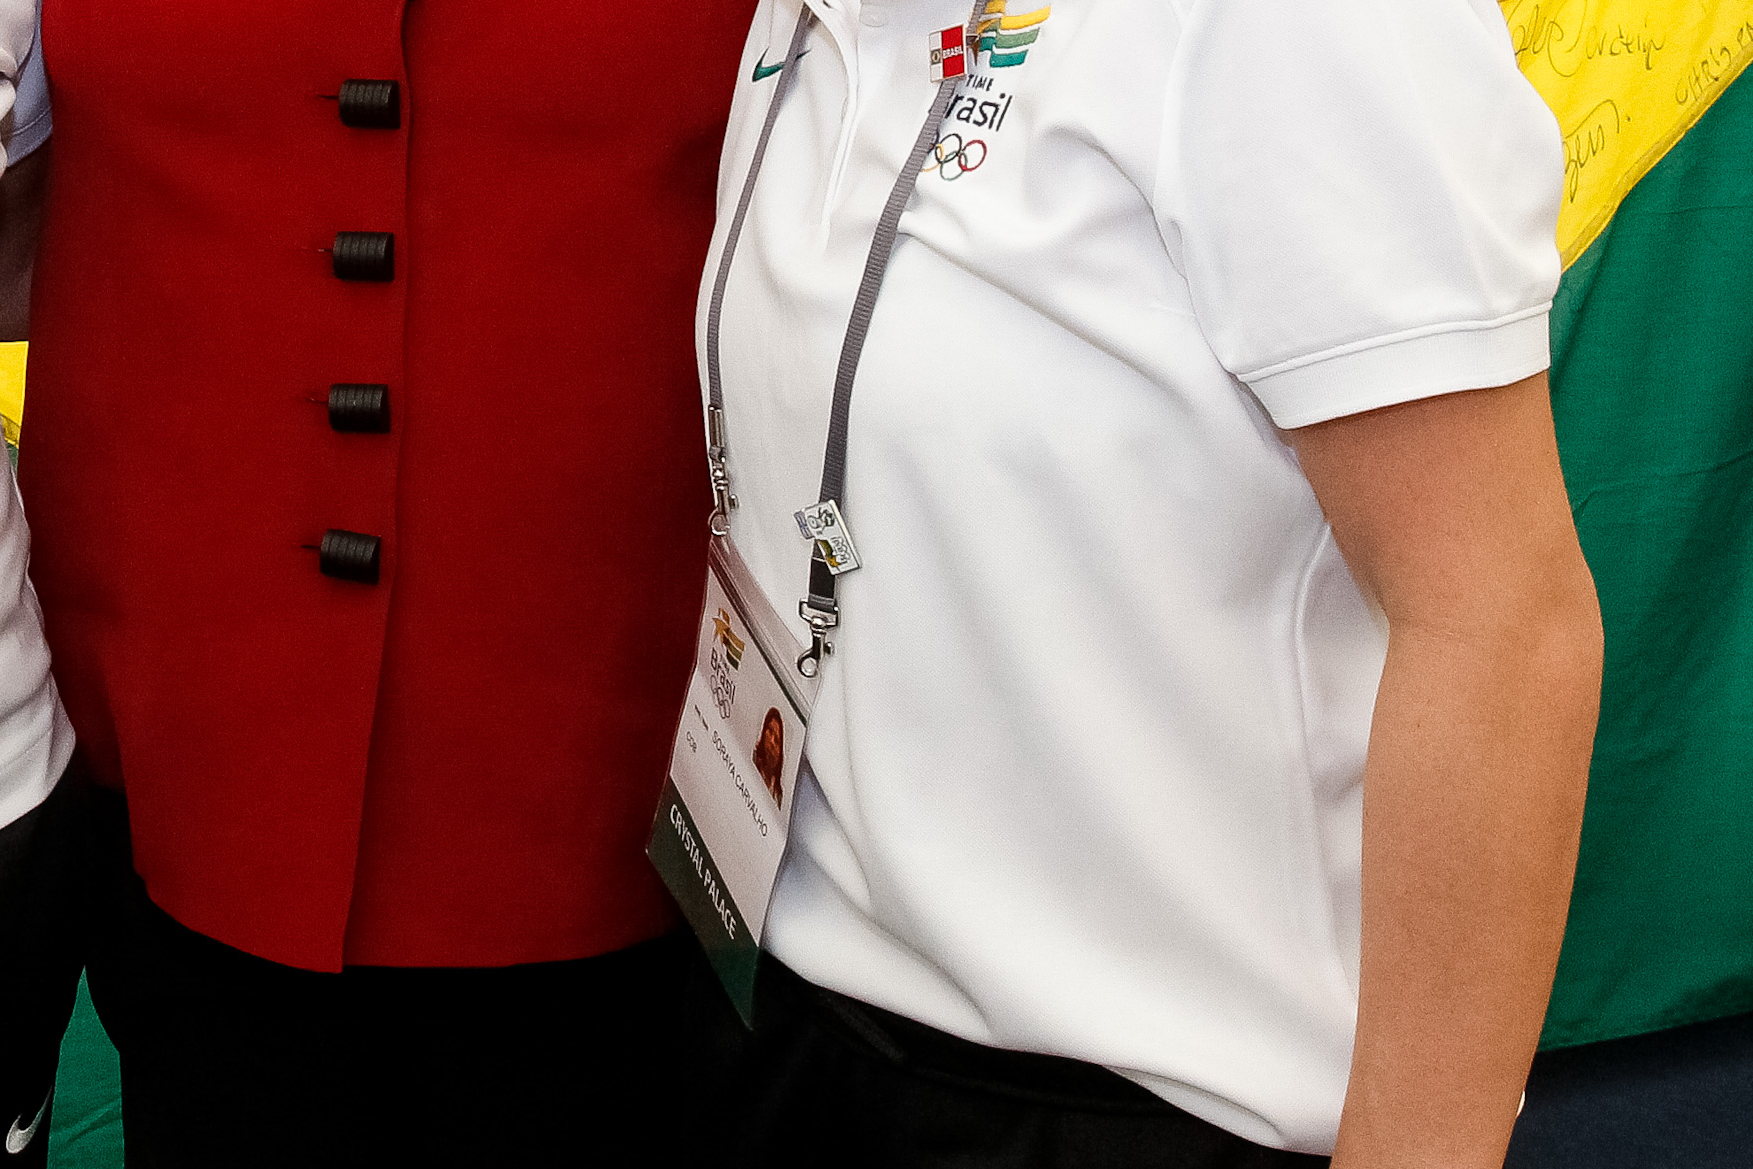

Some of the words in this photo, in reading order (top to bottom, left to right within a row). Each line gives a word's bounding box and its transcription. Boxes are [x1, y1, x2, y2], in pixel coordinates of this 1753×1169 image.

[942, 45, 963, 60] BRASIL
[966, 73, 994, 92] TIME
[944, 92, 1013, 132] rasil
[710, 647, 736, 705] Brasil
[712, 730, 736, 781] SORAYA
[734, 774, 768, 838] CARVALHO
[669, 804, 704, 879] CRYSTAL
[703, 868, 737, 940] PALACE
